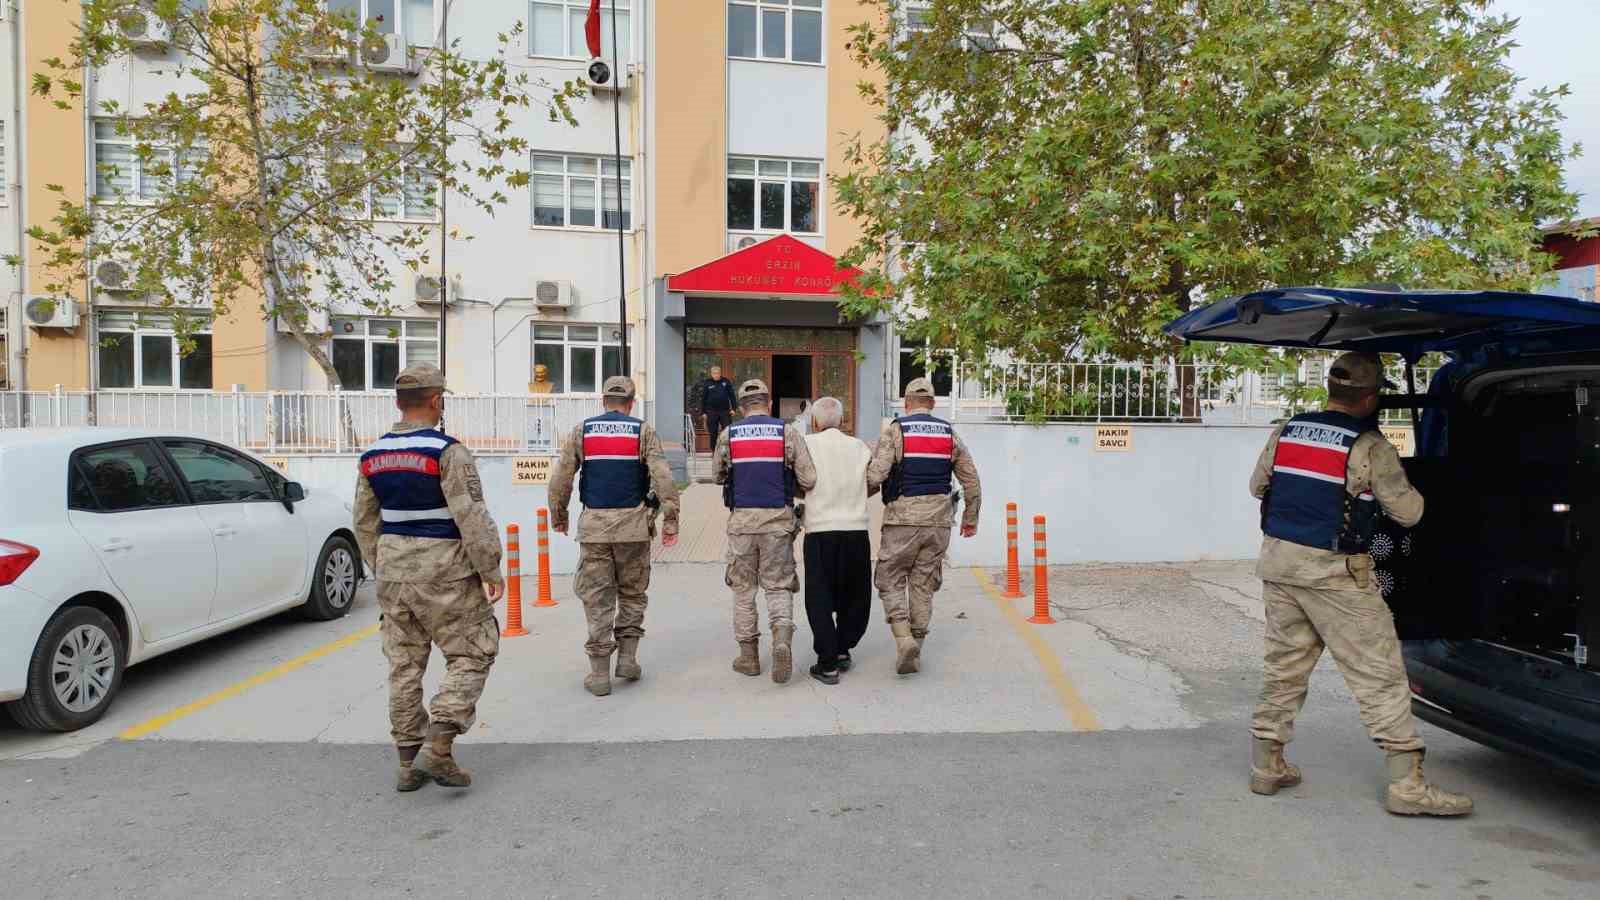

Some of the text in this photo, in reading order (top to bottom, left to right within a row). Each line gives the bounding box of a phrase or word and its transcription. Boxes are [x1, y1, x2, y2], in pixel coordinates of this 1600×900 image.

[589, 422, 633, 433] JANDARMA
[735, 425, 779, 438] JANDARMA
[1287, 424, 1345, 446] JANDARMA
[1099, 439, 1127, 447] SAVCI
[518, 472, 546, 480] SAVCI
